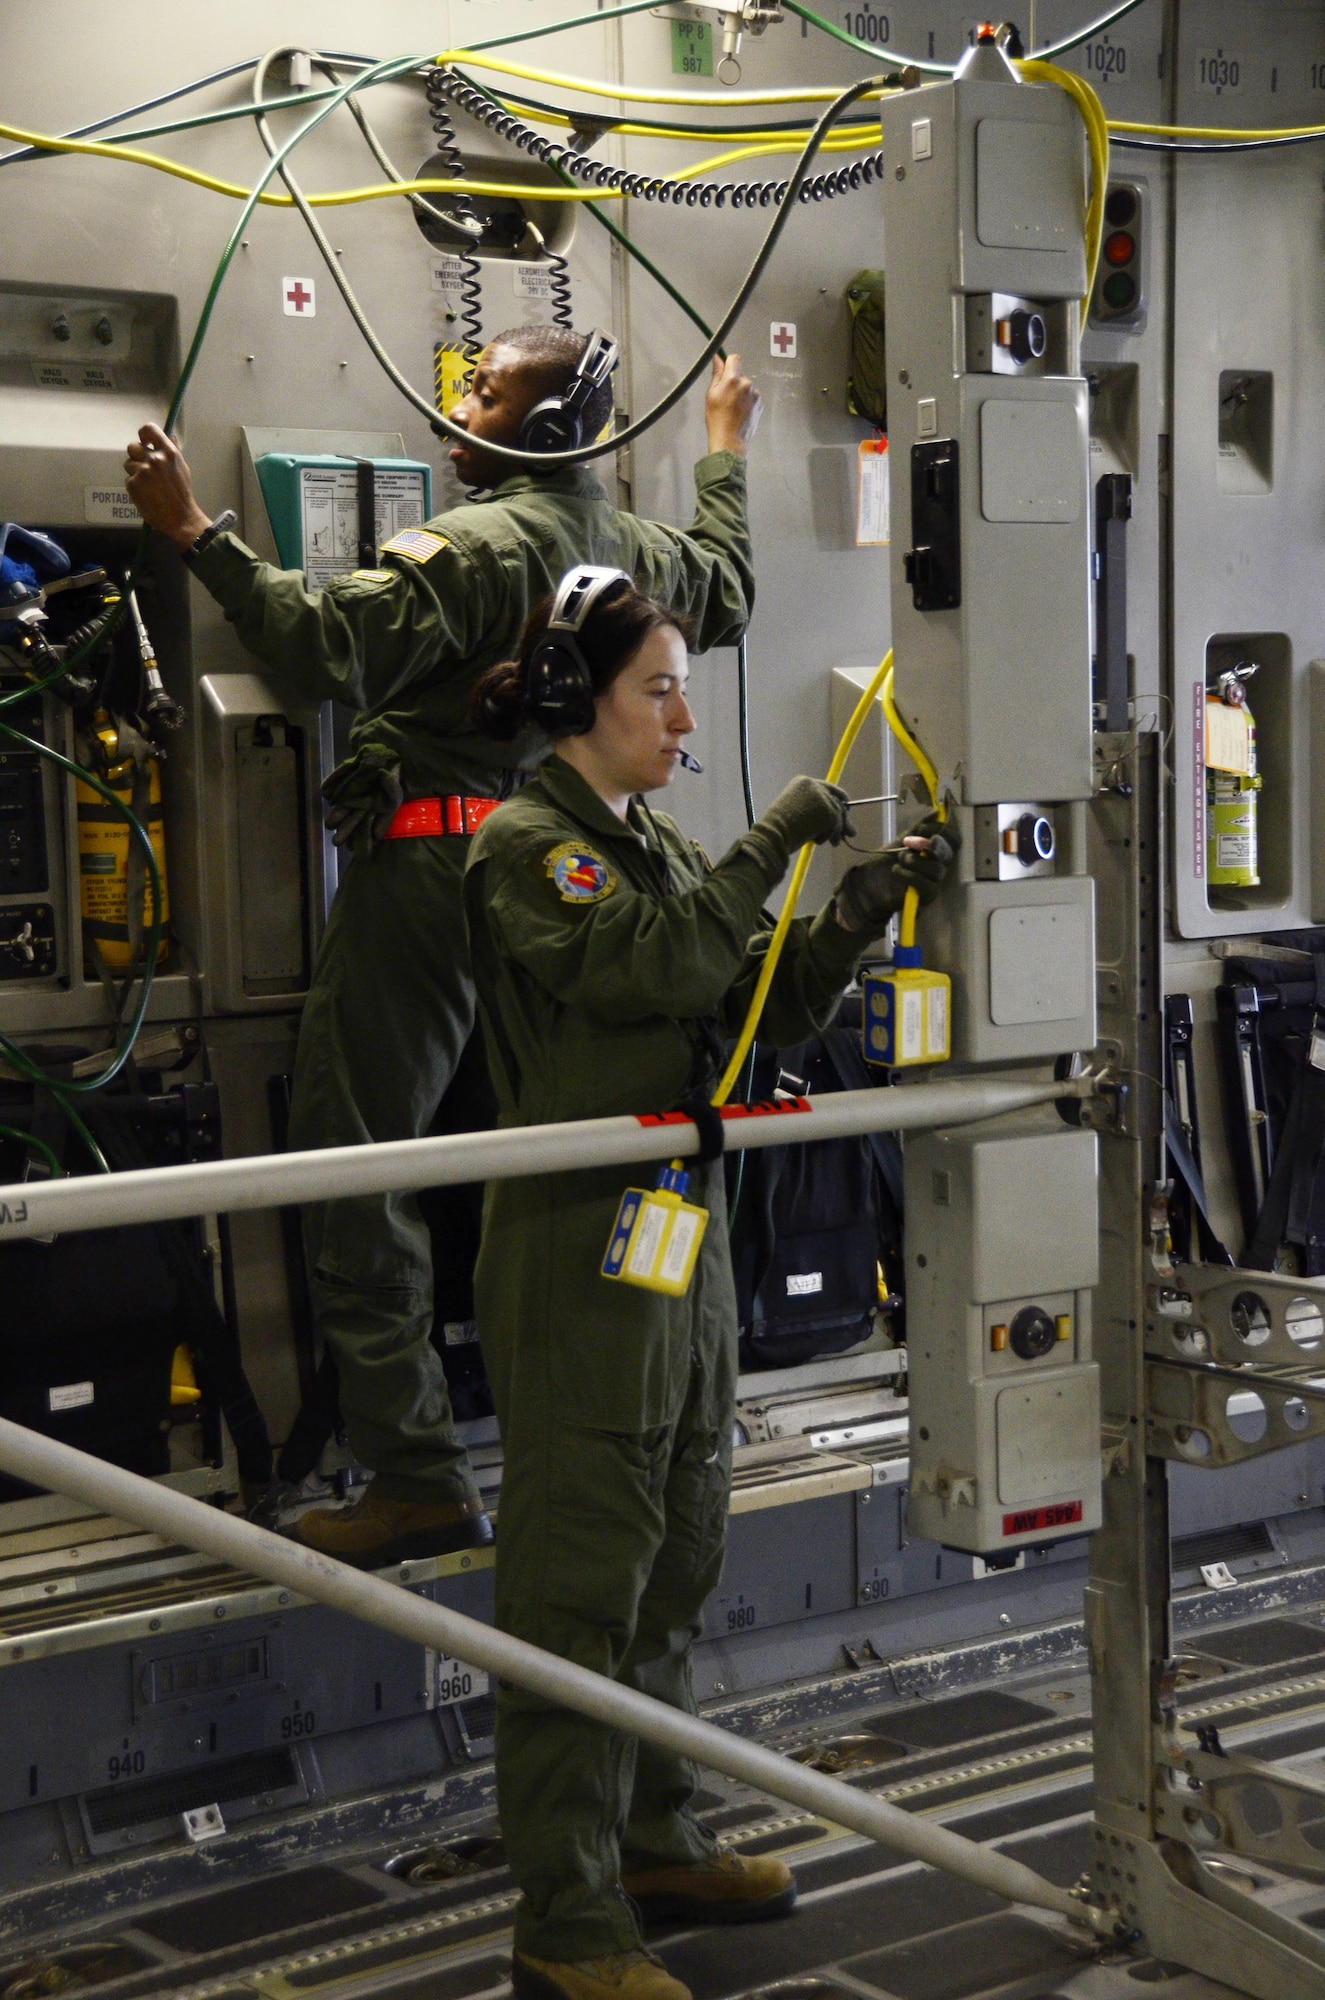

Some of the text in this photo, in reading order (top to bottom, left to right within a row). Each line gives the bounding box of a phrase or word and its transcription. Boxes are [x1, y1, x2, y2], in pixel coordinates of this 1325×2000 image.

[678, 22, 704, 40] PP 8
[844, 12, 890, 43] 1000
[682, 57, 702, 73] 987
[1085, 44, 1126, 74] 1020
[1200, 58, 1239, 87] 1030
[435, 270, 461, 279] EMERGE
[518, 267, 550, 277] AEROMEDI
[1012, 1511, 1038, 1532] AW
[727, 1605, 755, 1630] 980
[441, 1673, 472, 1701] 960
[281, 1711, 315, 1739] 950
[108, 1750, 145, 1780] 940
